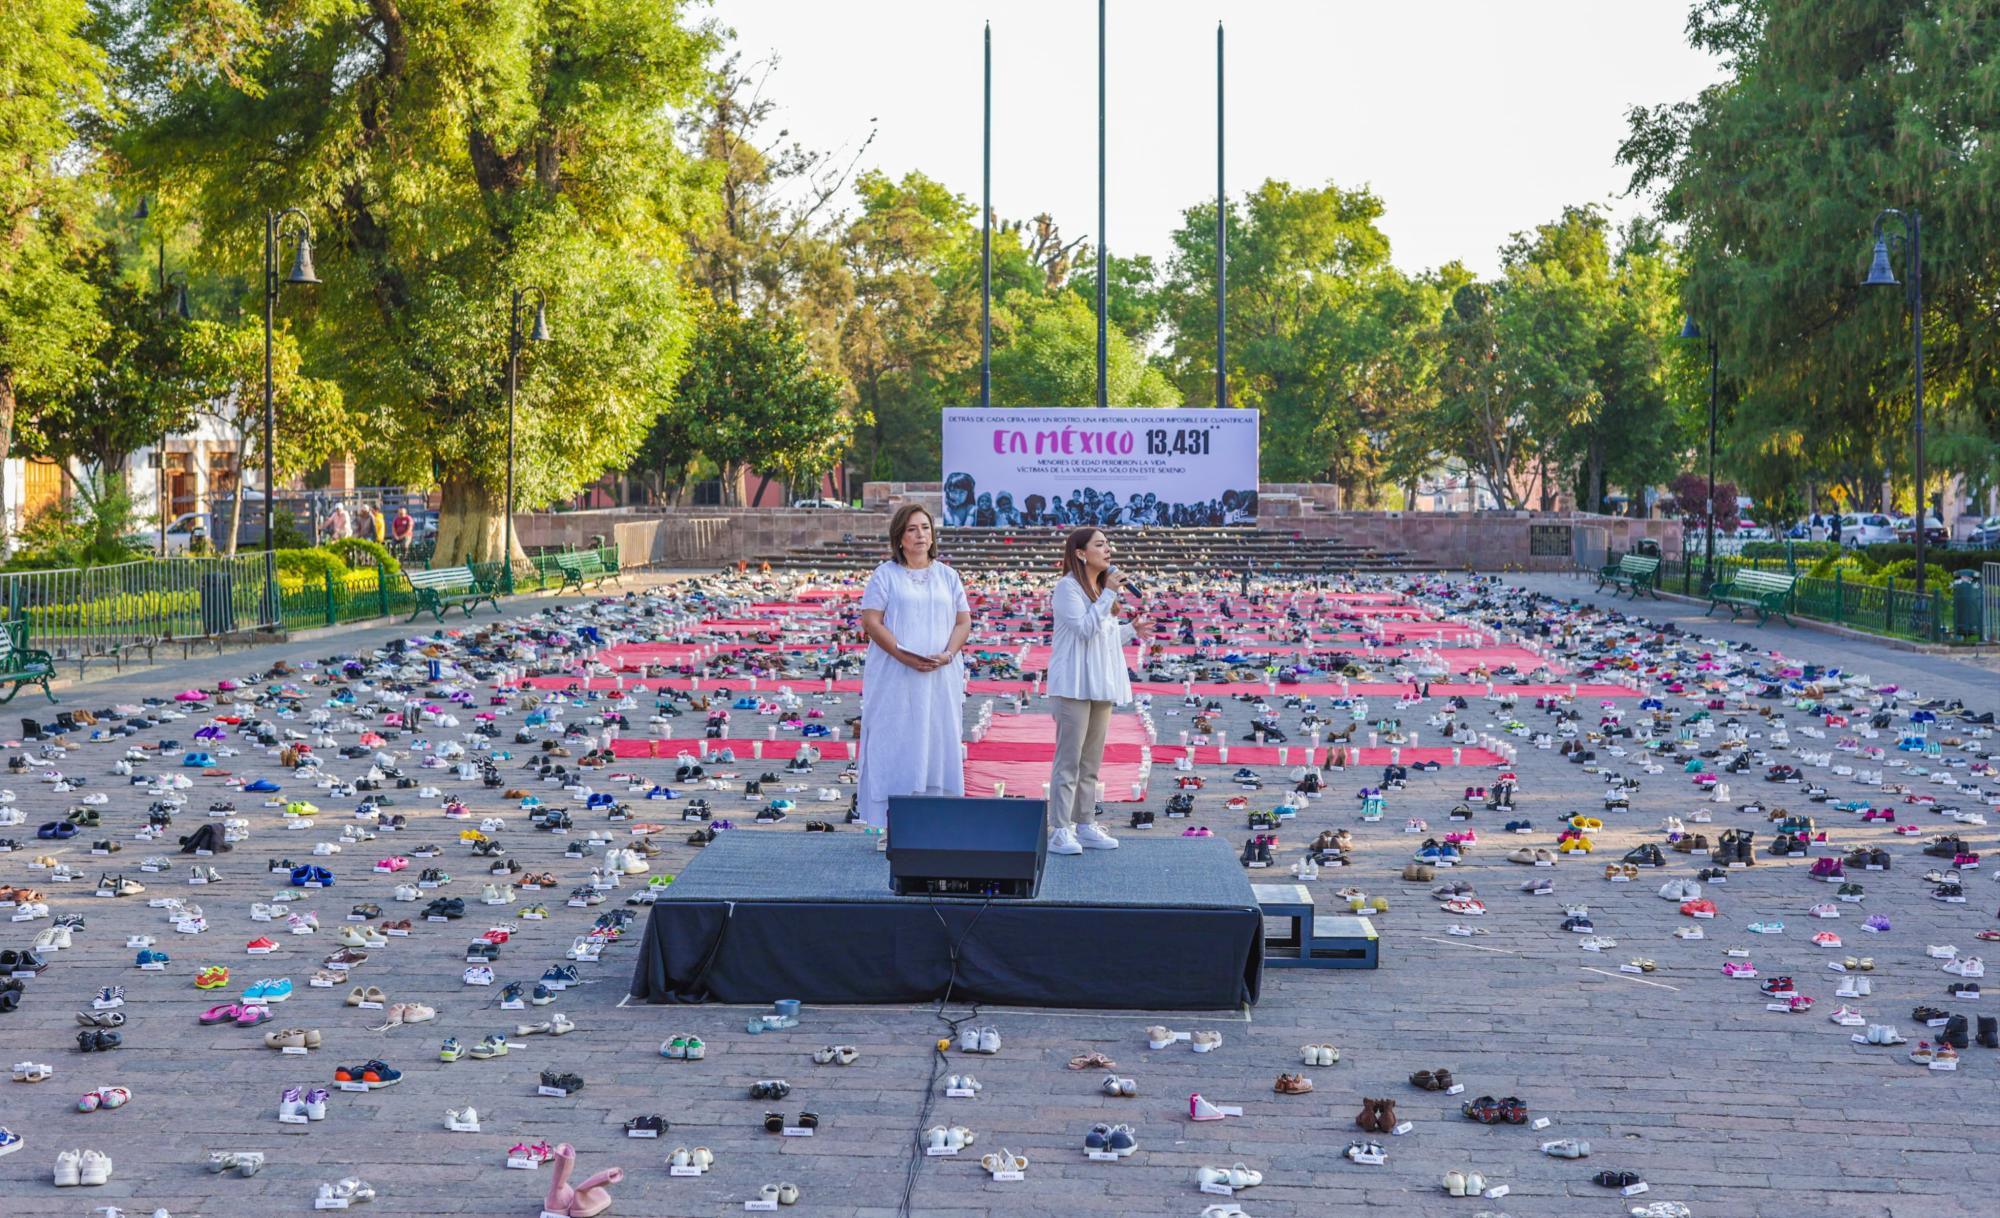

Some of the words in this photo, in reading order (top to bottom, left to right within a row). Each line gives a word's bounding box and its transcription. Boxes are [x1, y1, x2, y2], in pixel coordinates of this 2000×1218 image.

[948, 415, 974, 423] DETRÁS
[1035, 425, 1134, 455] MÉXICO
[1017, 465, 1049, 473] VÍCTIMAS
